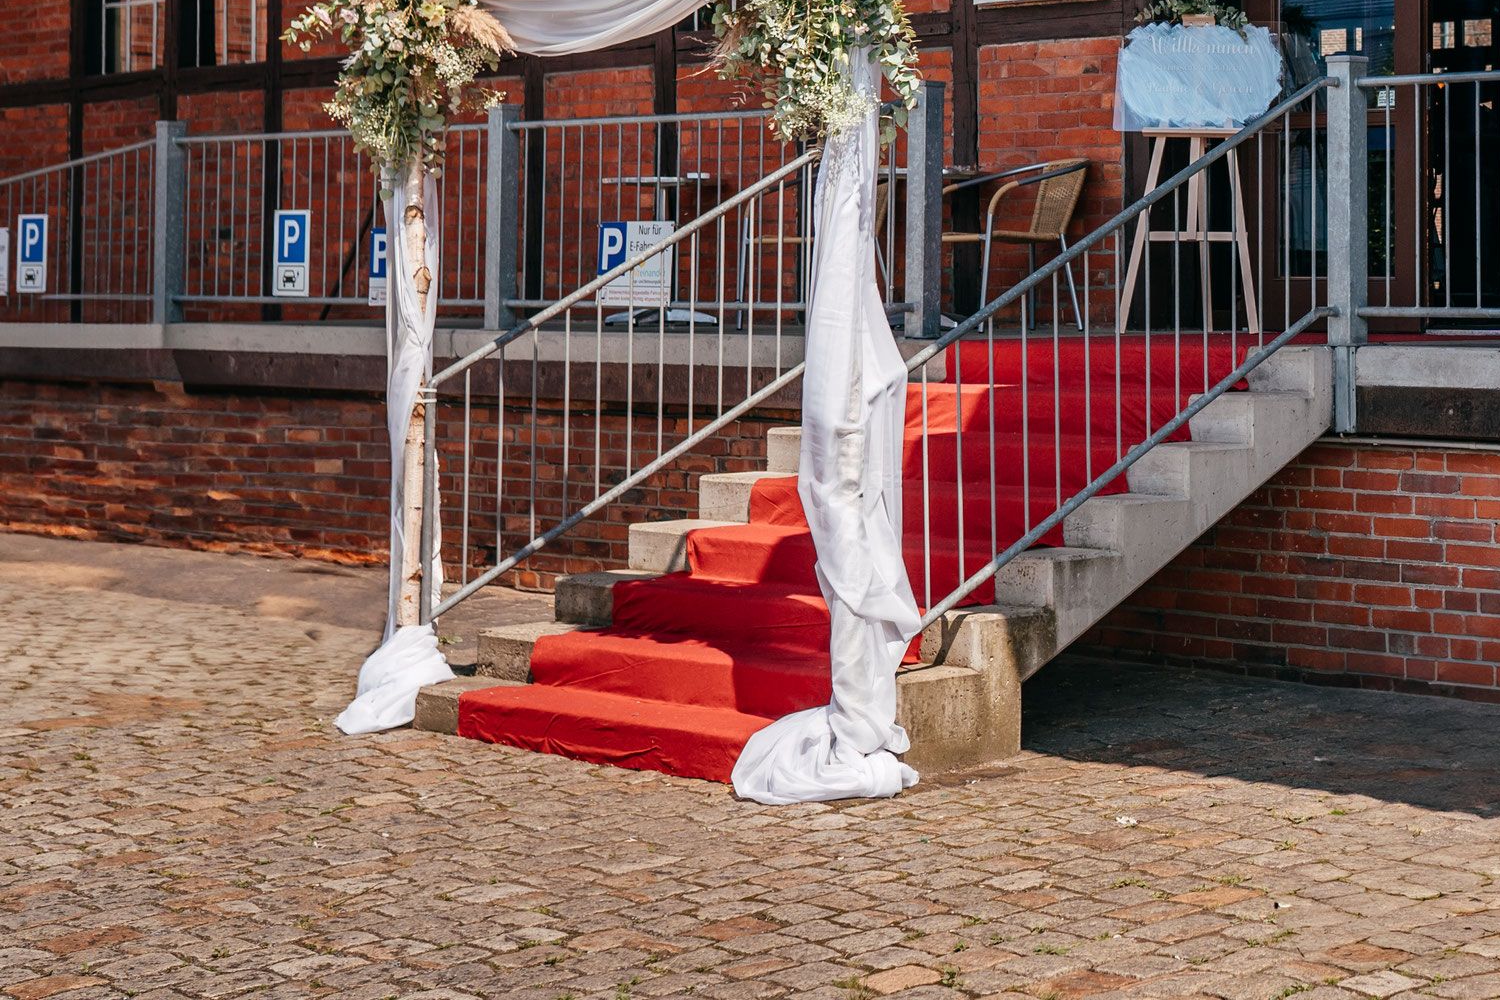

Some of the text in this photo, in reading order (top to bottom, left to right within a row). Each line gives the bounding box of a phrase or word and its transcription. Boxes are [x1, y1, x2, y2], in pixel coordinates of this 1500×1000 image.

[25, 223, 39, 258] P
[283, 219, 300, 258] P
[638, 224, 662, 235] Nur für
[601, 227, 623, 270] P
